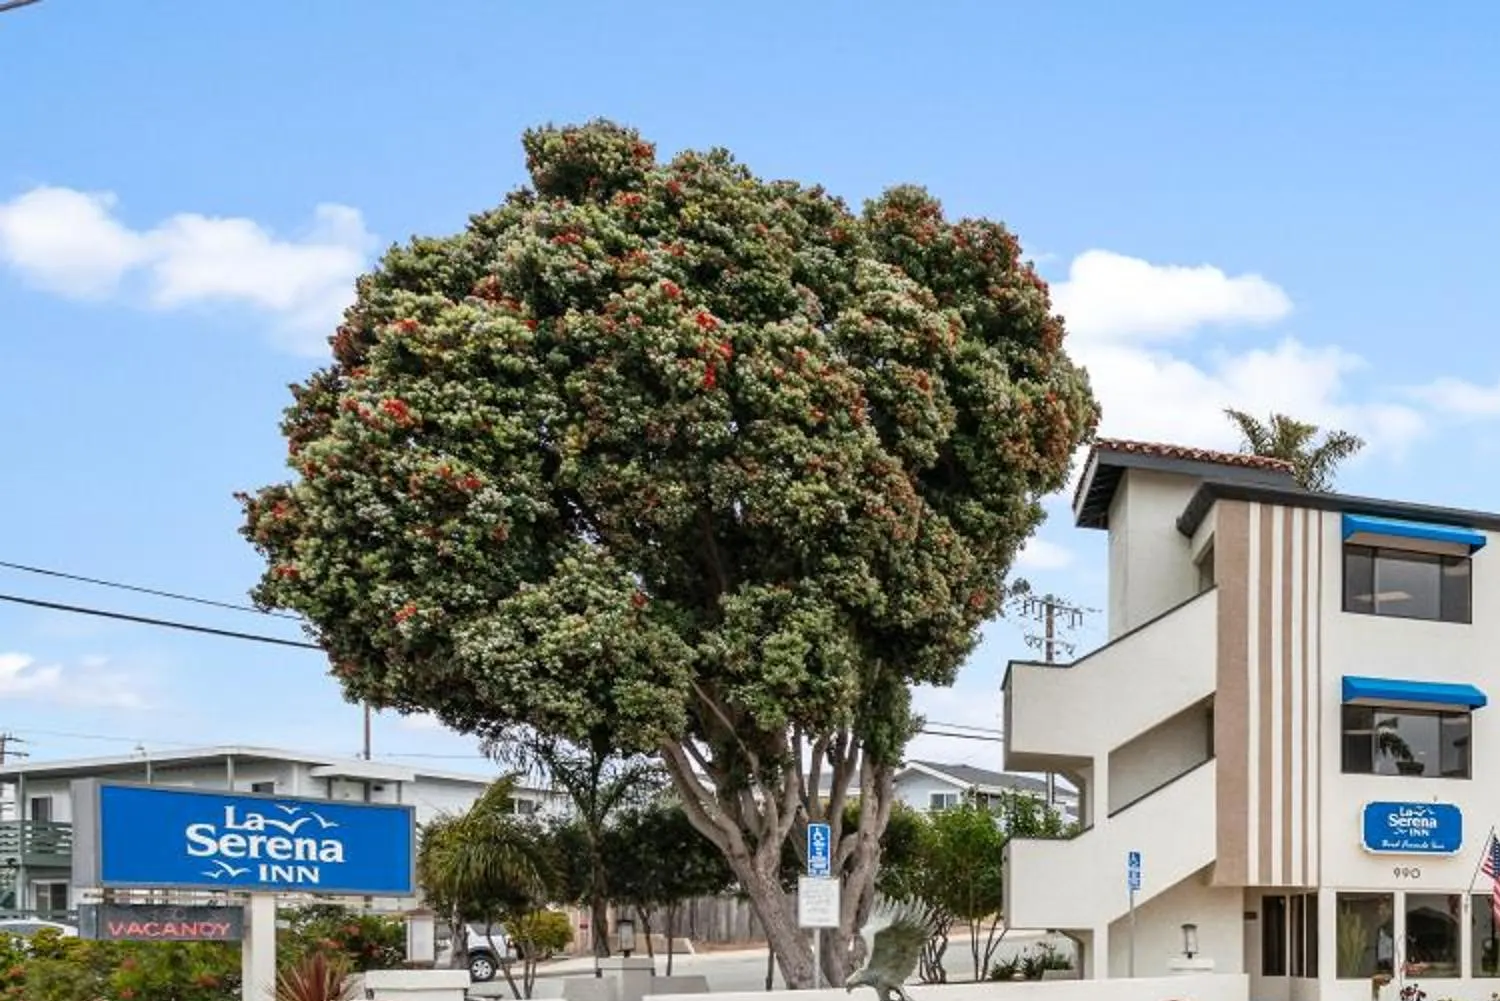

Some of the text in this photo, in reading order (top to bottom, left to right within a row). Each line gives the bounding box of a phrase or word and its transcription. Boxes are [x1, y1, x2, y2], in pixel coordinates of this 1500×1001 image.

[224, 805, 265, 831] La
[1388, 813, 1437, 828] Serena
[185, 824, 345, 863] Serena
[258, 864, 319, 883] INN
[1394, 867, 1421, 879] 990
[108, 921, 231, 938] VACANCY
